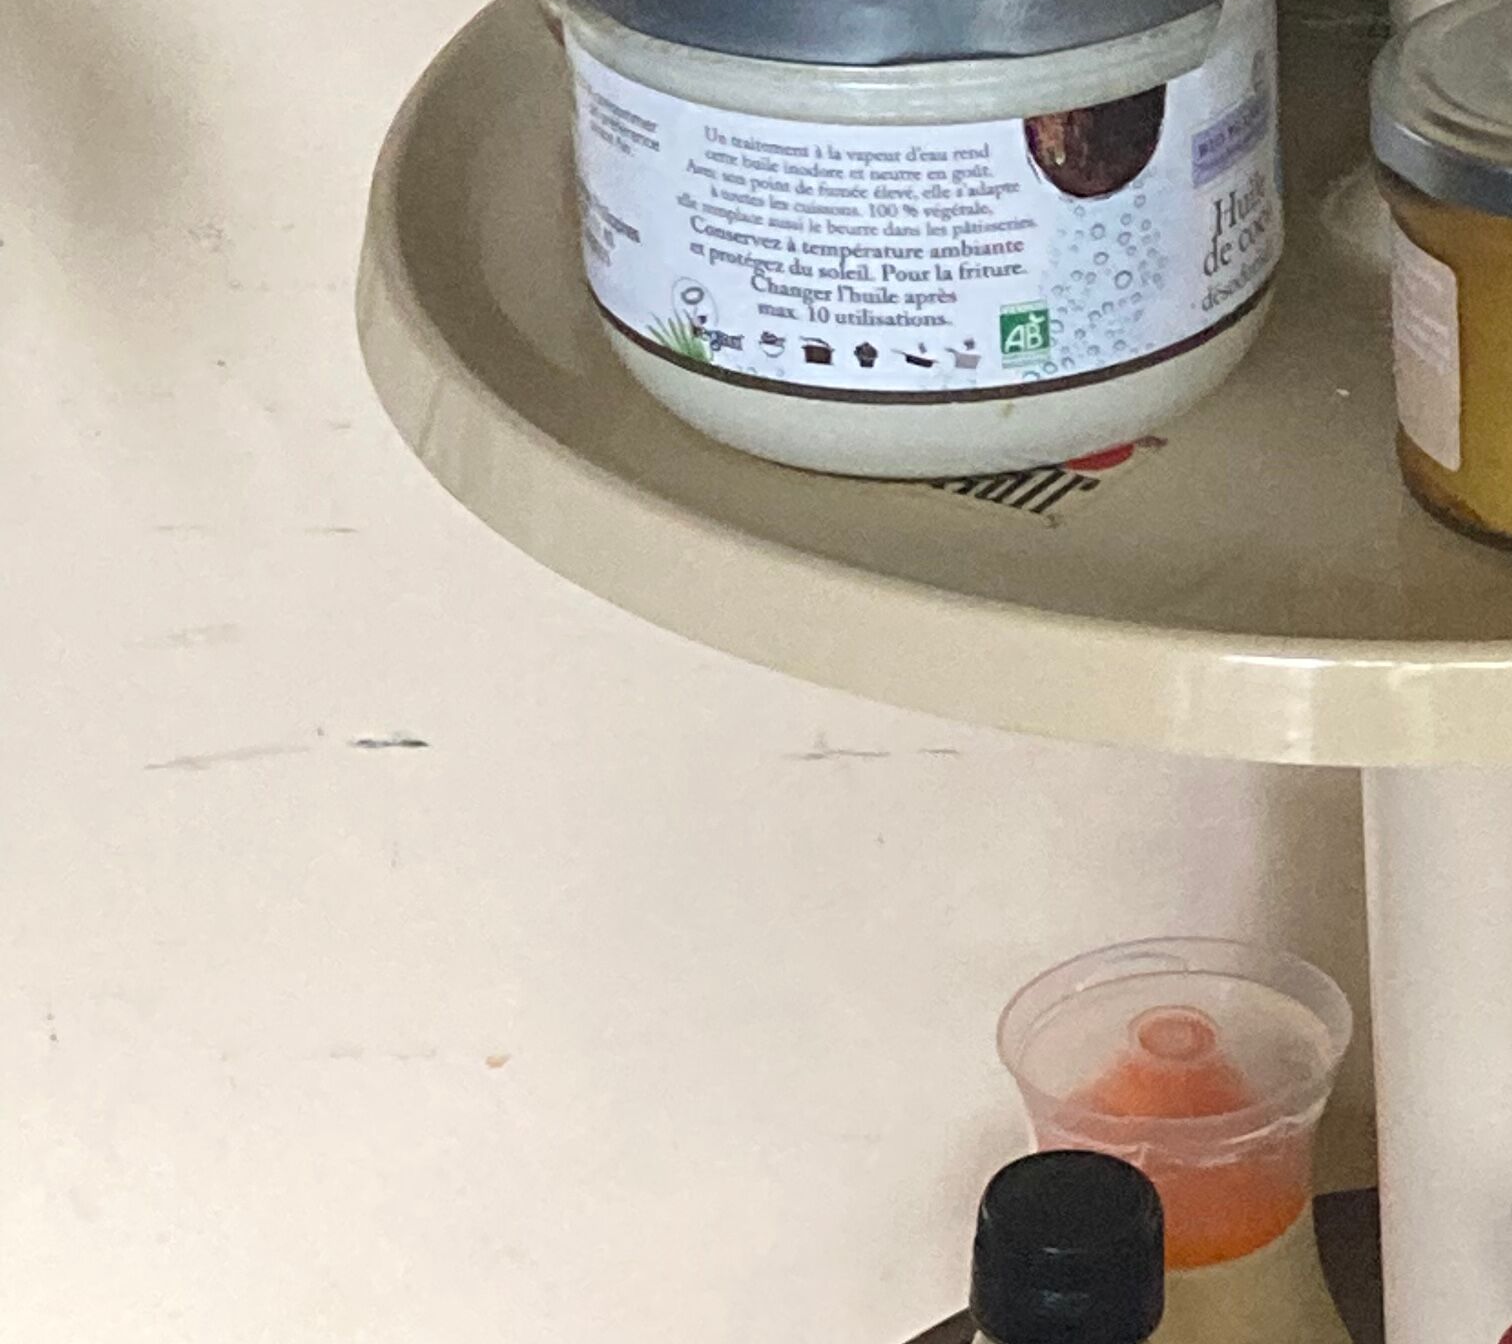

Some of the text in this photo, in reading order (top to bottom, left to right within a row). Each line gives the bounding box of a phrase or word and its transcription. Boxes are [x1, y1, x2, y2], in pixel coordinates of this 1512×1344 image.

[731, 136, 810, 157] traitement
[828, 144, 842, 160] la
[846, 150, 902, 167] vapeur
[905, 145, 948, 162] d'eau
[952, 142, 990, 160] rend
[783, 160, 844, 178] inodore
[849, 168, 865, 181] et
[870, 169, 922, 182] neutre
[926, 169, 947, 181] en
[952, 165, 994, 185] goût.
[750, 176, 791, 194] point
[795, 178, 814, 195] de
[818, 180, 868, 200] fumée
[873, 183, 920, 201] élevé,
[921, 183, 951, 200] elle
[956, 180, 1021, 200] s'adapte
[769, 194, 789, 210] les
[794, 199, 863, 217] cuissons.
[869, 203, 899, 218] 100
[902, 204, 919, 218] %
[923, 201, 994, 221] végétale,
[808, 217, 822, 234] le
[826, 219, 879, 236] beurre
[883, 220, 920, 236] dans
[926, 221, 948, 236] les
[690, 214, 1025, 269] Conservez à température ambiante
[1203, 232, 1232, 277] de
[689, 242, 1029, 282] et protégez du soleil. Pour la friture.
[751, 274, 958, 311] Changer l'huile après
[807, 305, 831, 324] 10
[834, 307, 952, 327] utilisations.
